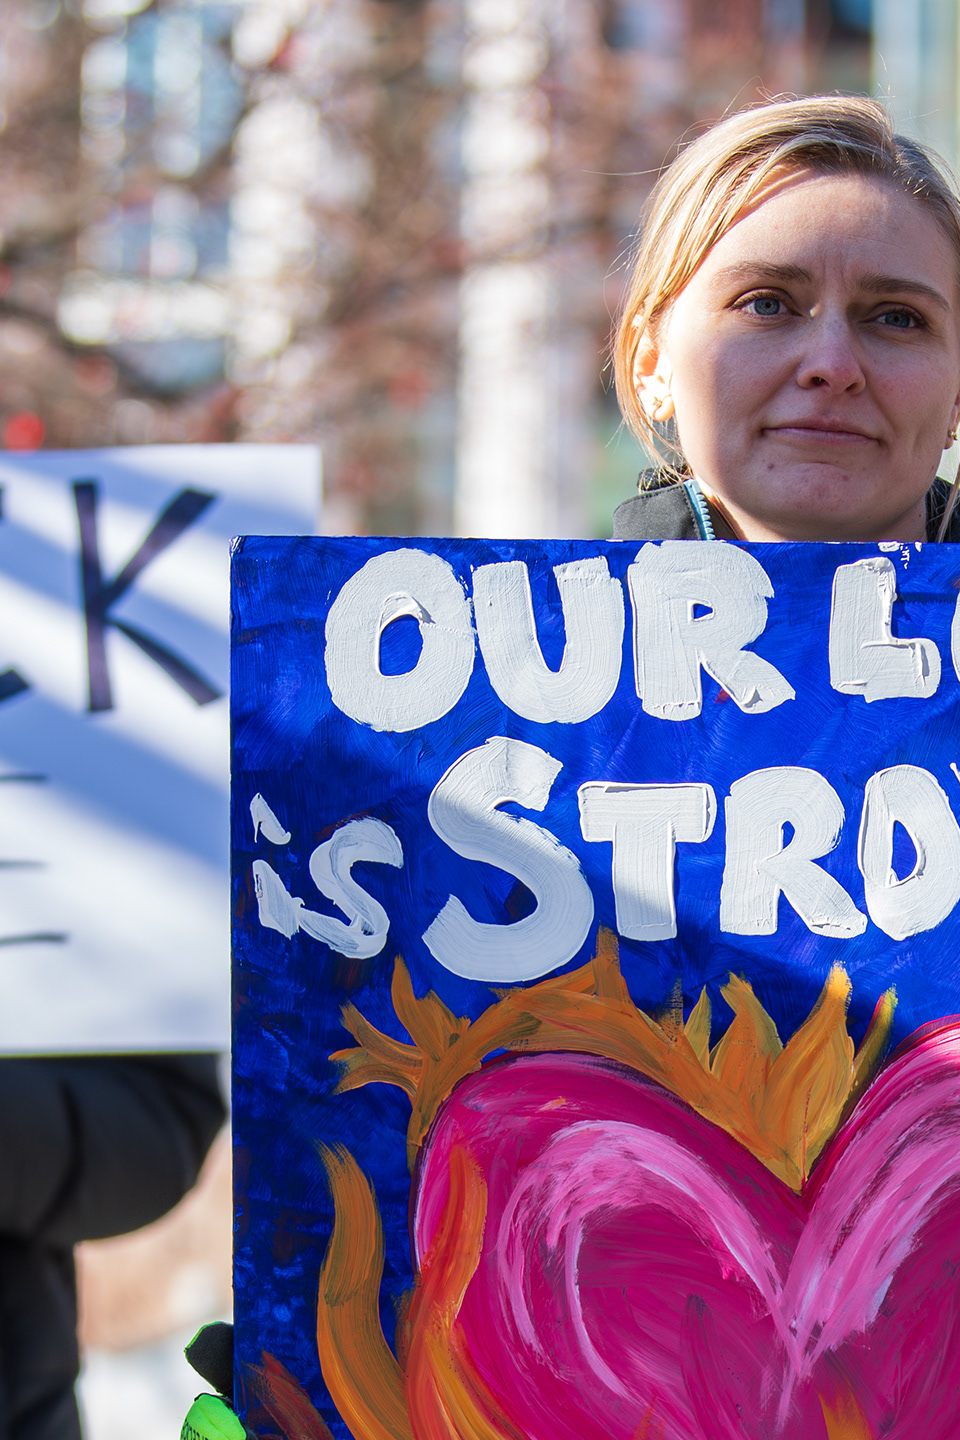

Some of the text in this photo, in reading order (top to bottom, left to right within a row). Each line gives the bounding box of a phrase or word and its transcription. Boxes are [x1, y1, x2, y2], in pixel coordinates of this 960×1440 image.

[0, 478, 221, 712] K
[324, 543, 796, 733] OUR
[250, 793, 403, 959] is
